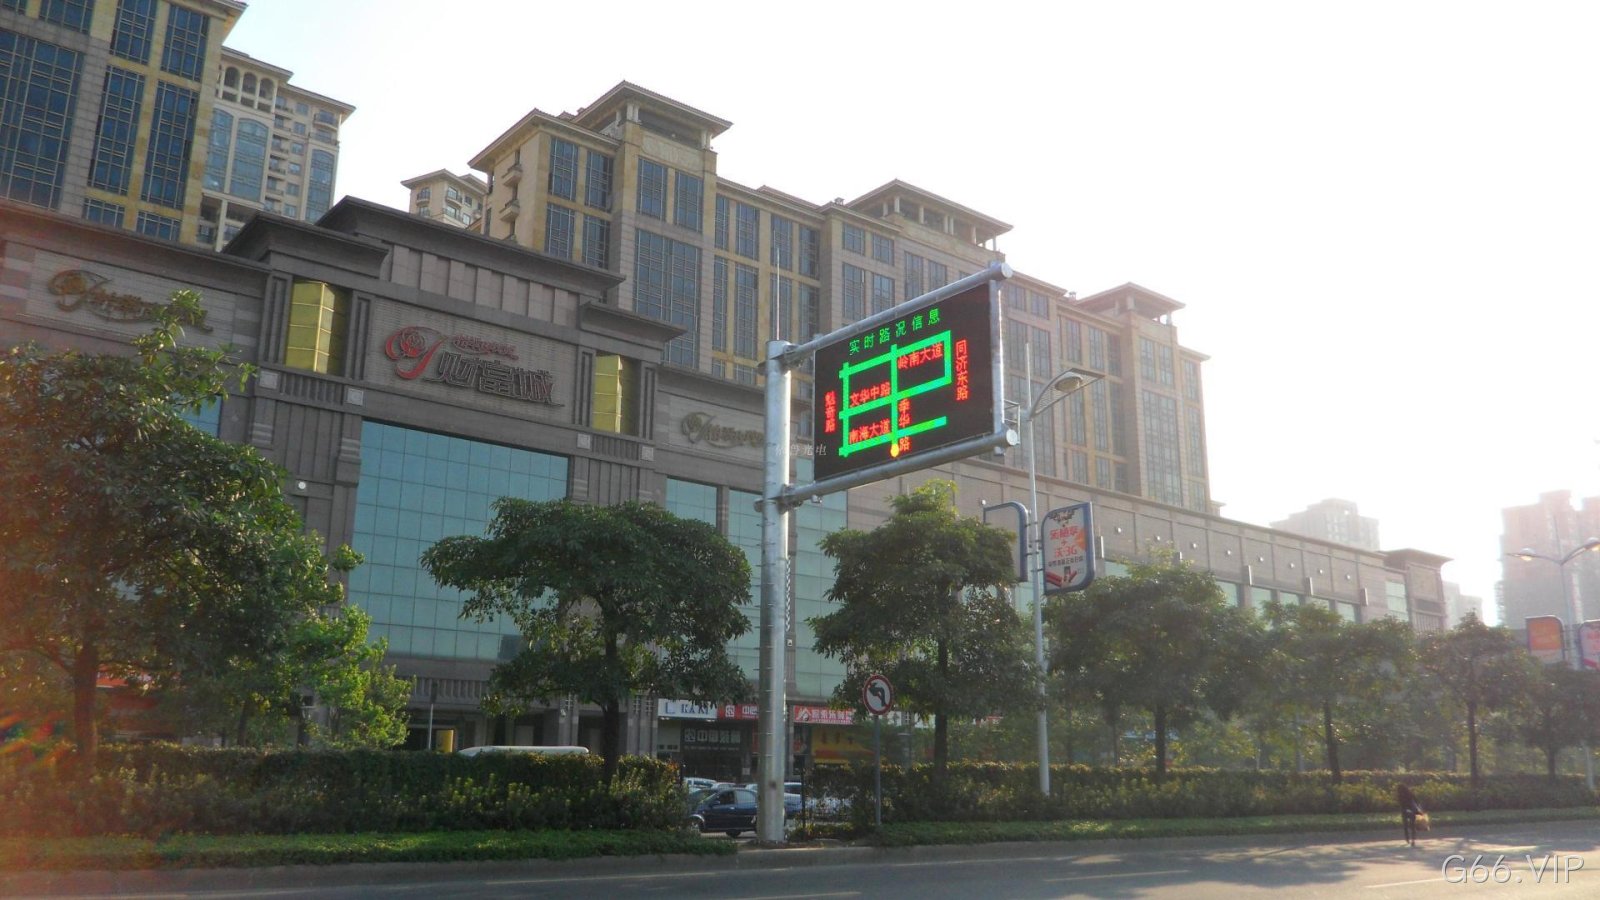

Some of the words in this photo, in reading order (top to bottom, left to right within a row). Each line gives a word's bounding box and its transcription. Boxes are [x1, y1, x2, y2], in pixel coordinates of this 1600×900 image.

[849, 308, 941, 356] 实时路况信息
[897, 342, 944, 370] 岭南大道
[955, 339, 969, 401] 同济东路
[850, 381, 891, 407] 文华中路
[849, 418, 891, 444] 南海大道
